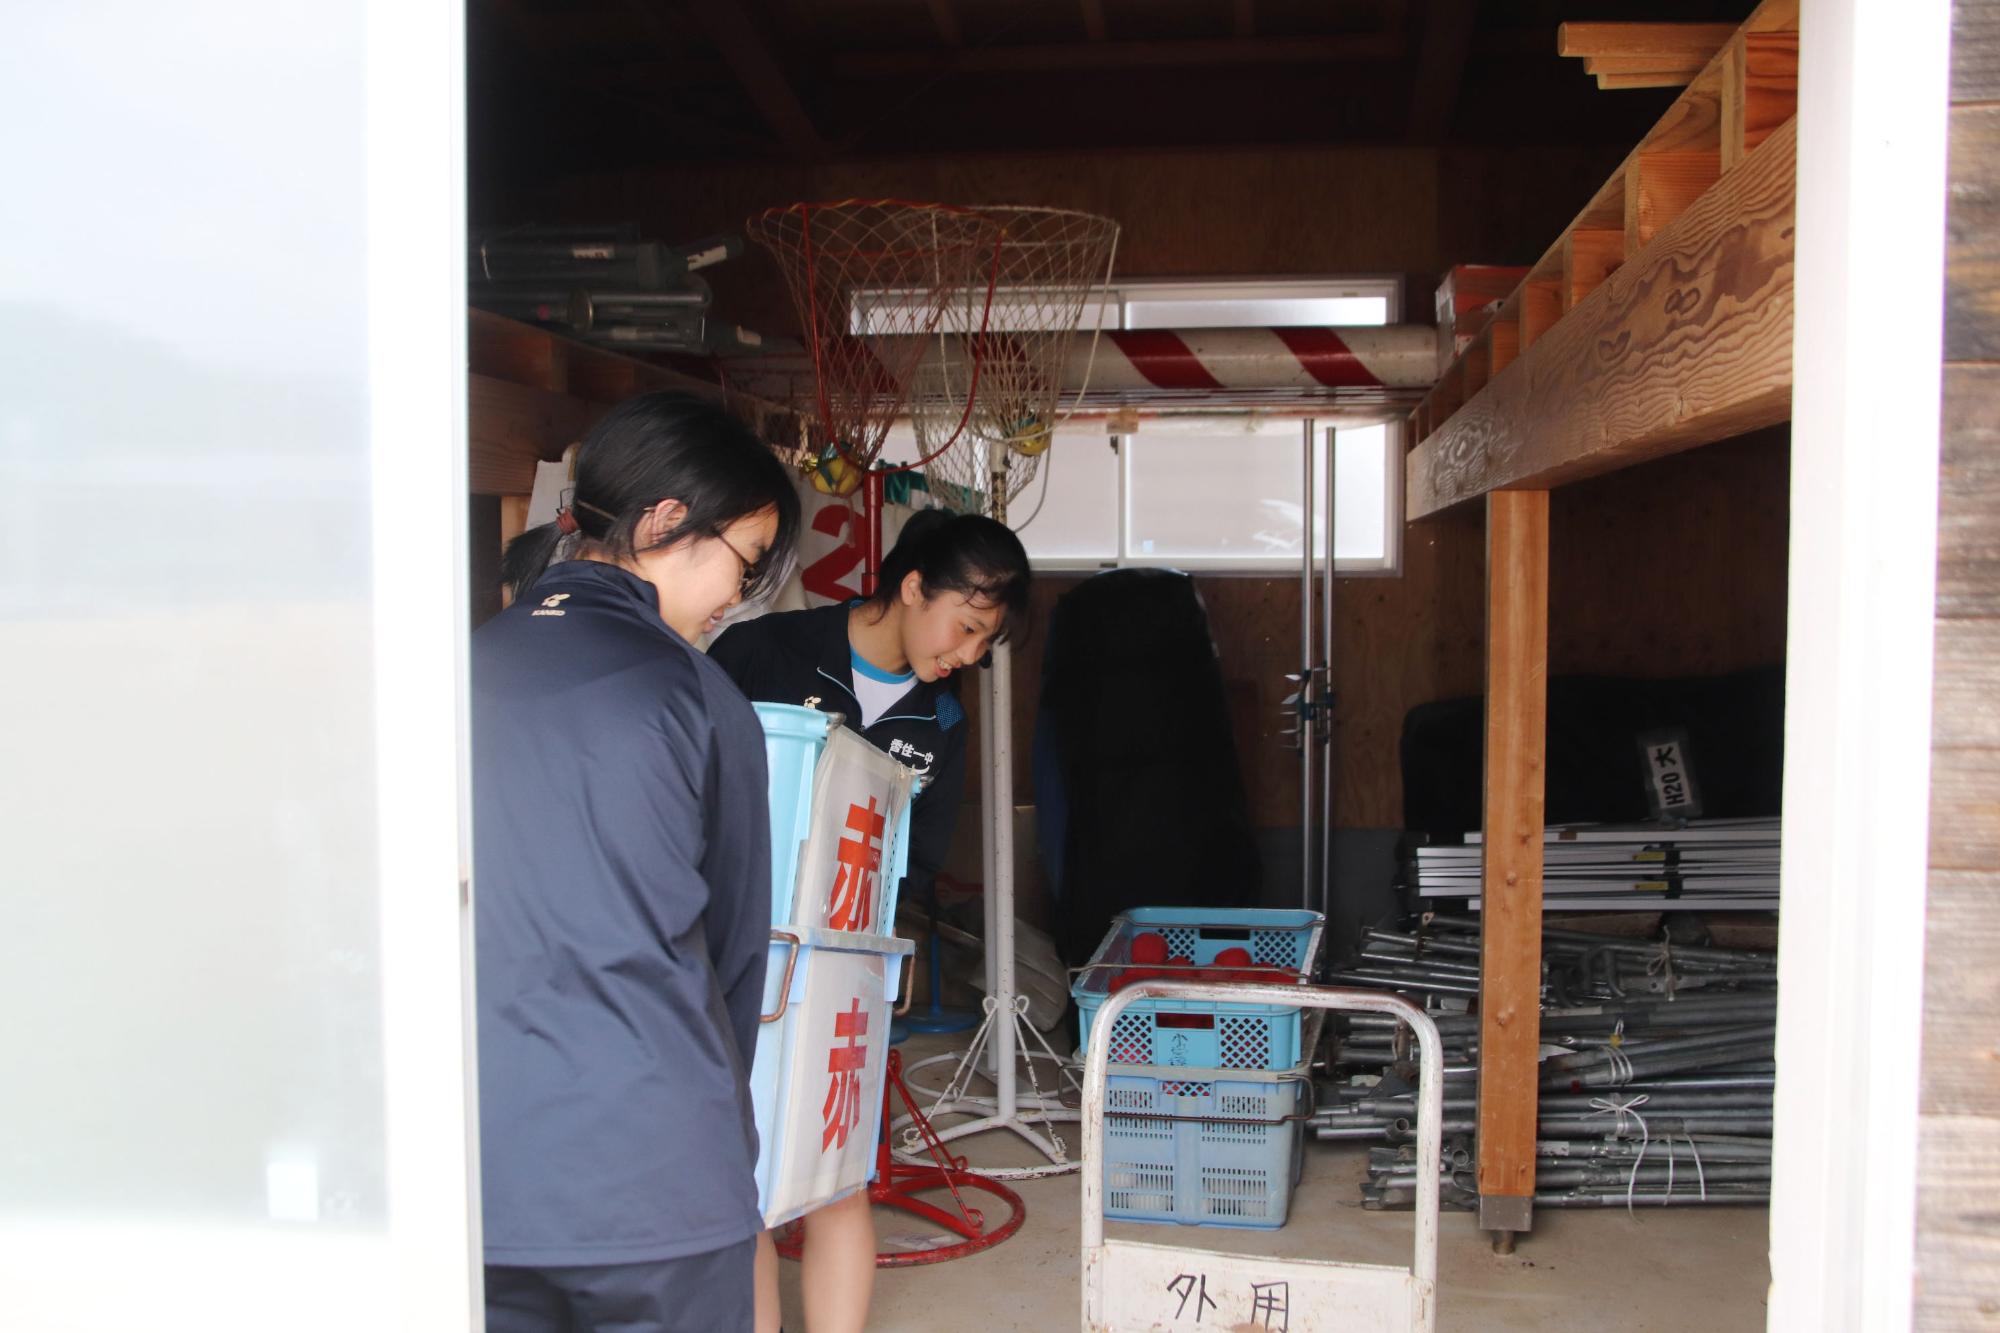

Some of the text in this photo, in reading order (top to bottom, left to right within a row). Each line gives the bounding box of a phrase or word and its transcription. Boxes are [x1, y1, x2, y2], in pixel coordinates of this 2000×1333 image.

[801, 504, 869, 604] 2
[889, 738, 934, 765] 香住一中
[829, 795, 885, 932] 赤
[821, 997, 869, 1155] 赤
